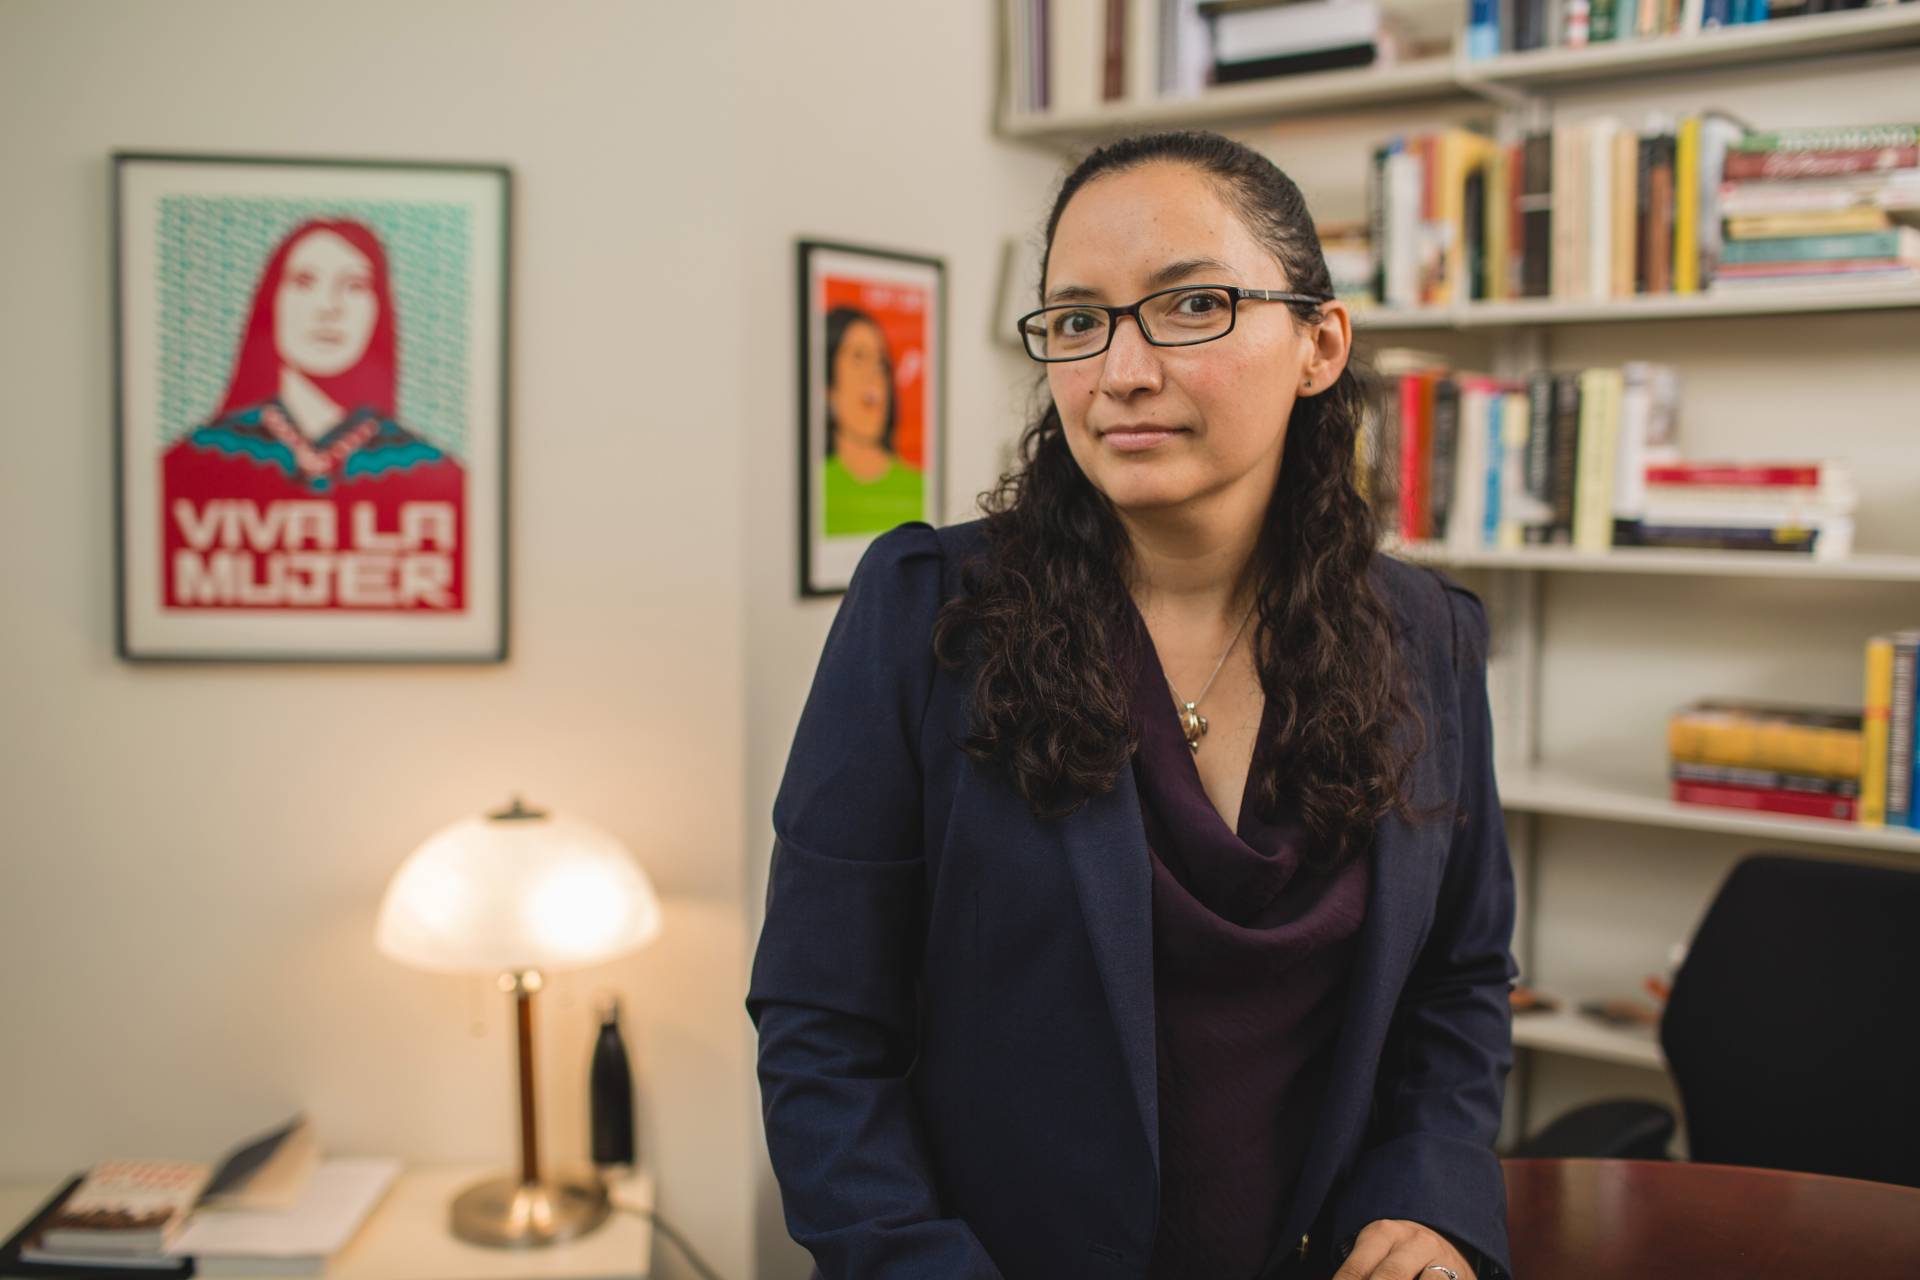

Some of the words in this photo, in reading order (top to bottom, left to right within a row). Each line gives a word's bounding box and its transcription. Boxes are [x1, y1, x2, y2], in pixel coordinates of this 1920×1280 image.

[174, 498, 336, 549] VIVA
[354, 501, 454, 550] LA
[176, 550, 456, 607] MUJER
